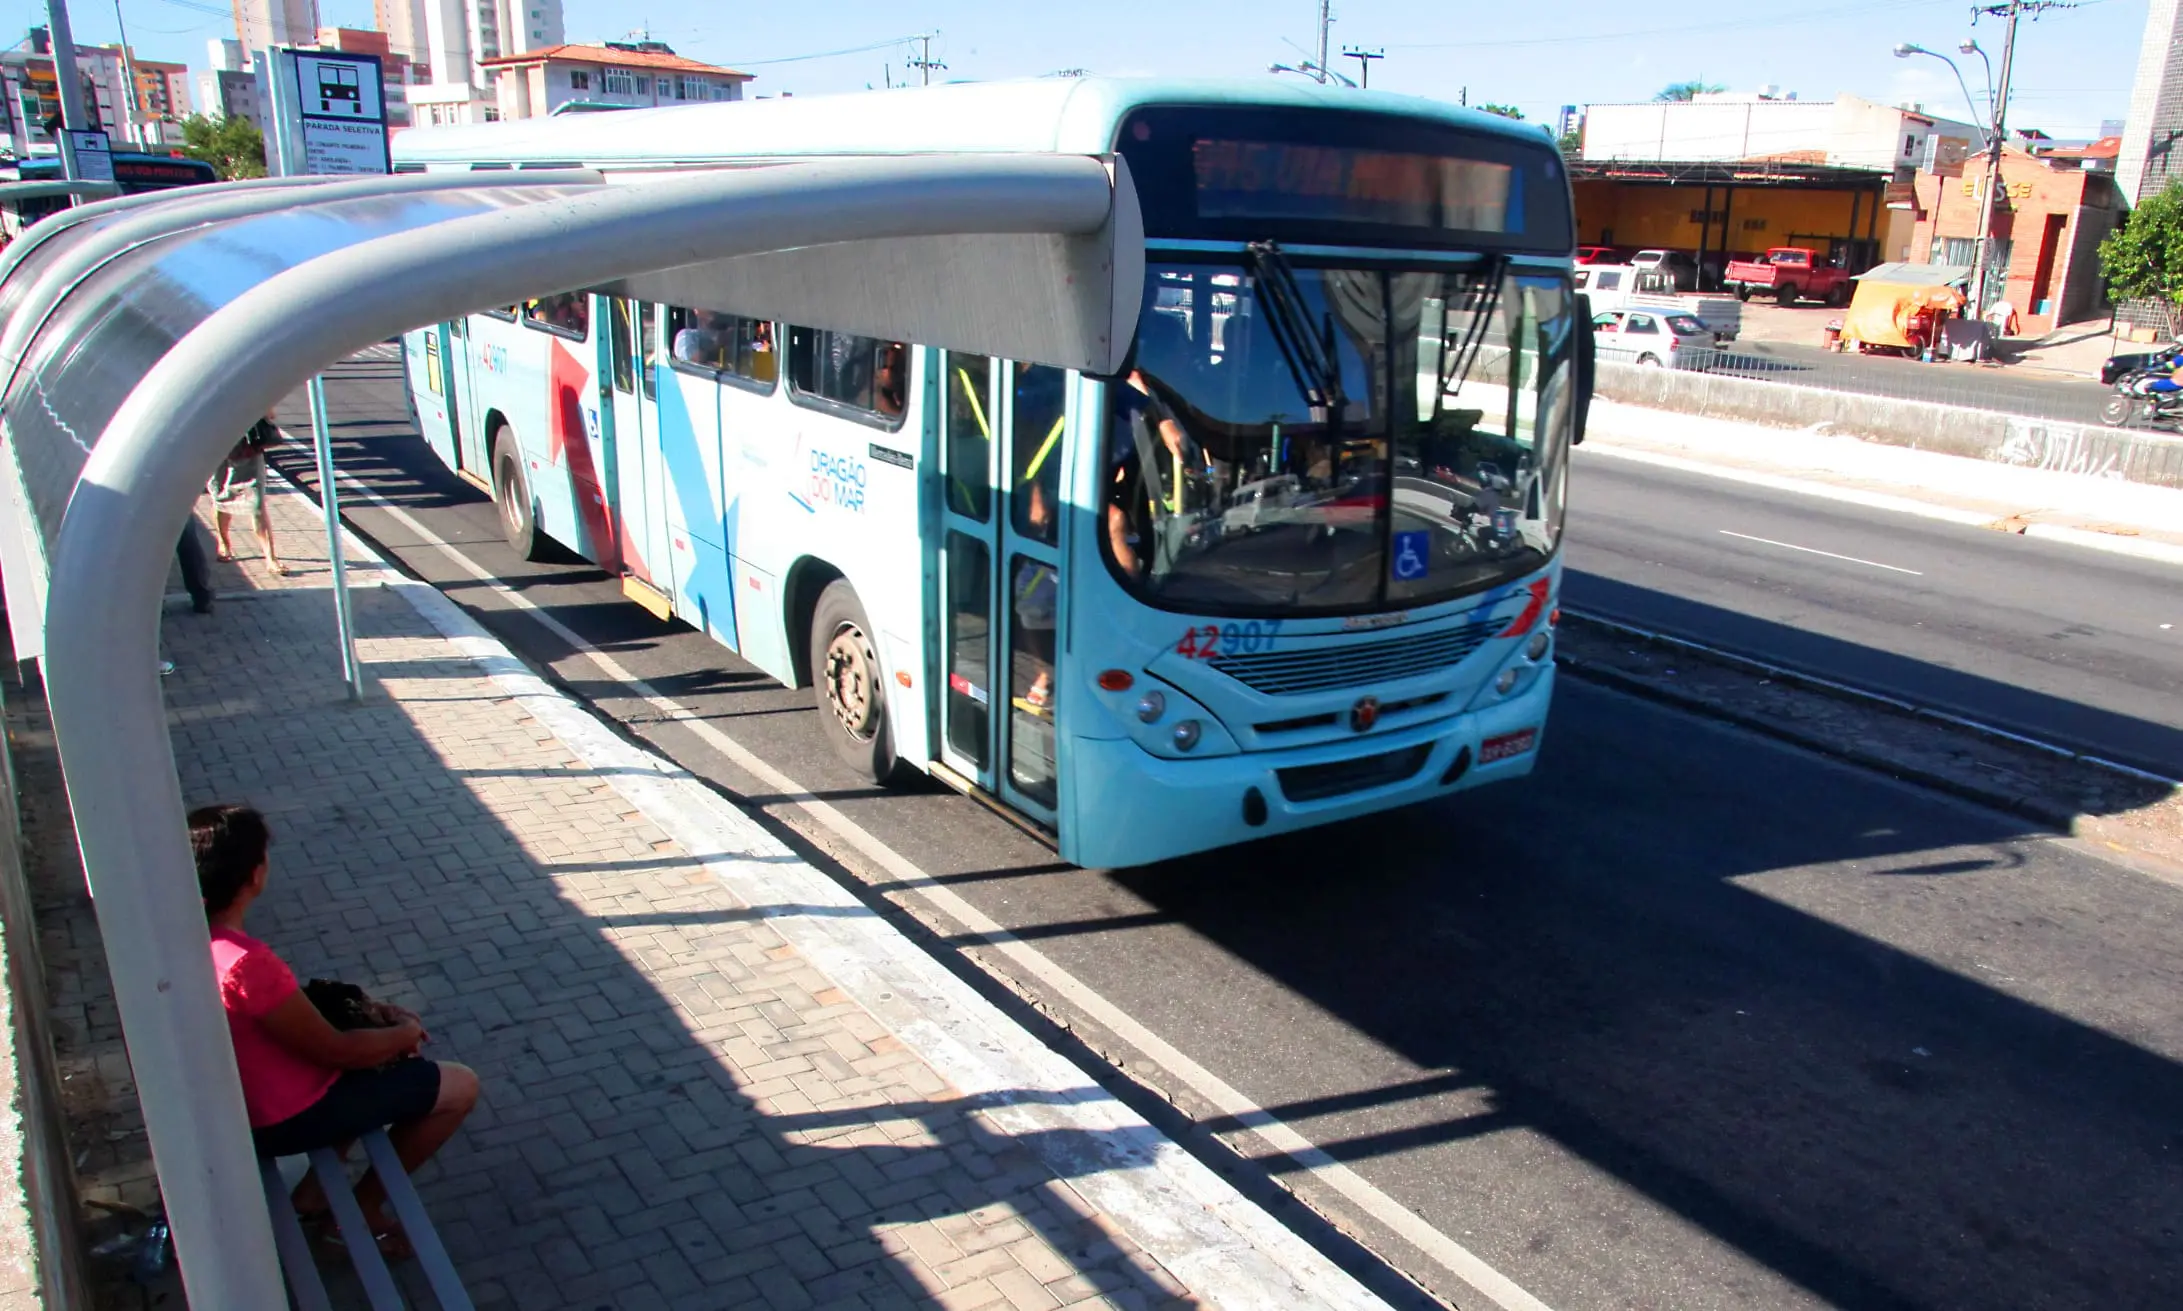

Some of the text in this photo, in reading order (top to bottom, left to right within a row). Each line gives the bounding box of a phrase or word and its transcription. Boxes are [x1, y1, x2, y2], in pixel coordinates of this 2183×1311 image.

[305, 121, 380, 135] PARADA SELETIVA
[811, 449, 866, 488] DRAGÃO
[812, 475, 866, 515] DO MAR
[1176, 618, 1284, 660] 42907
